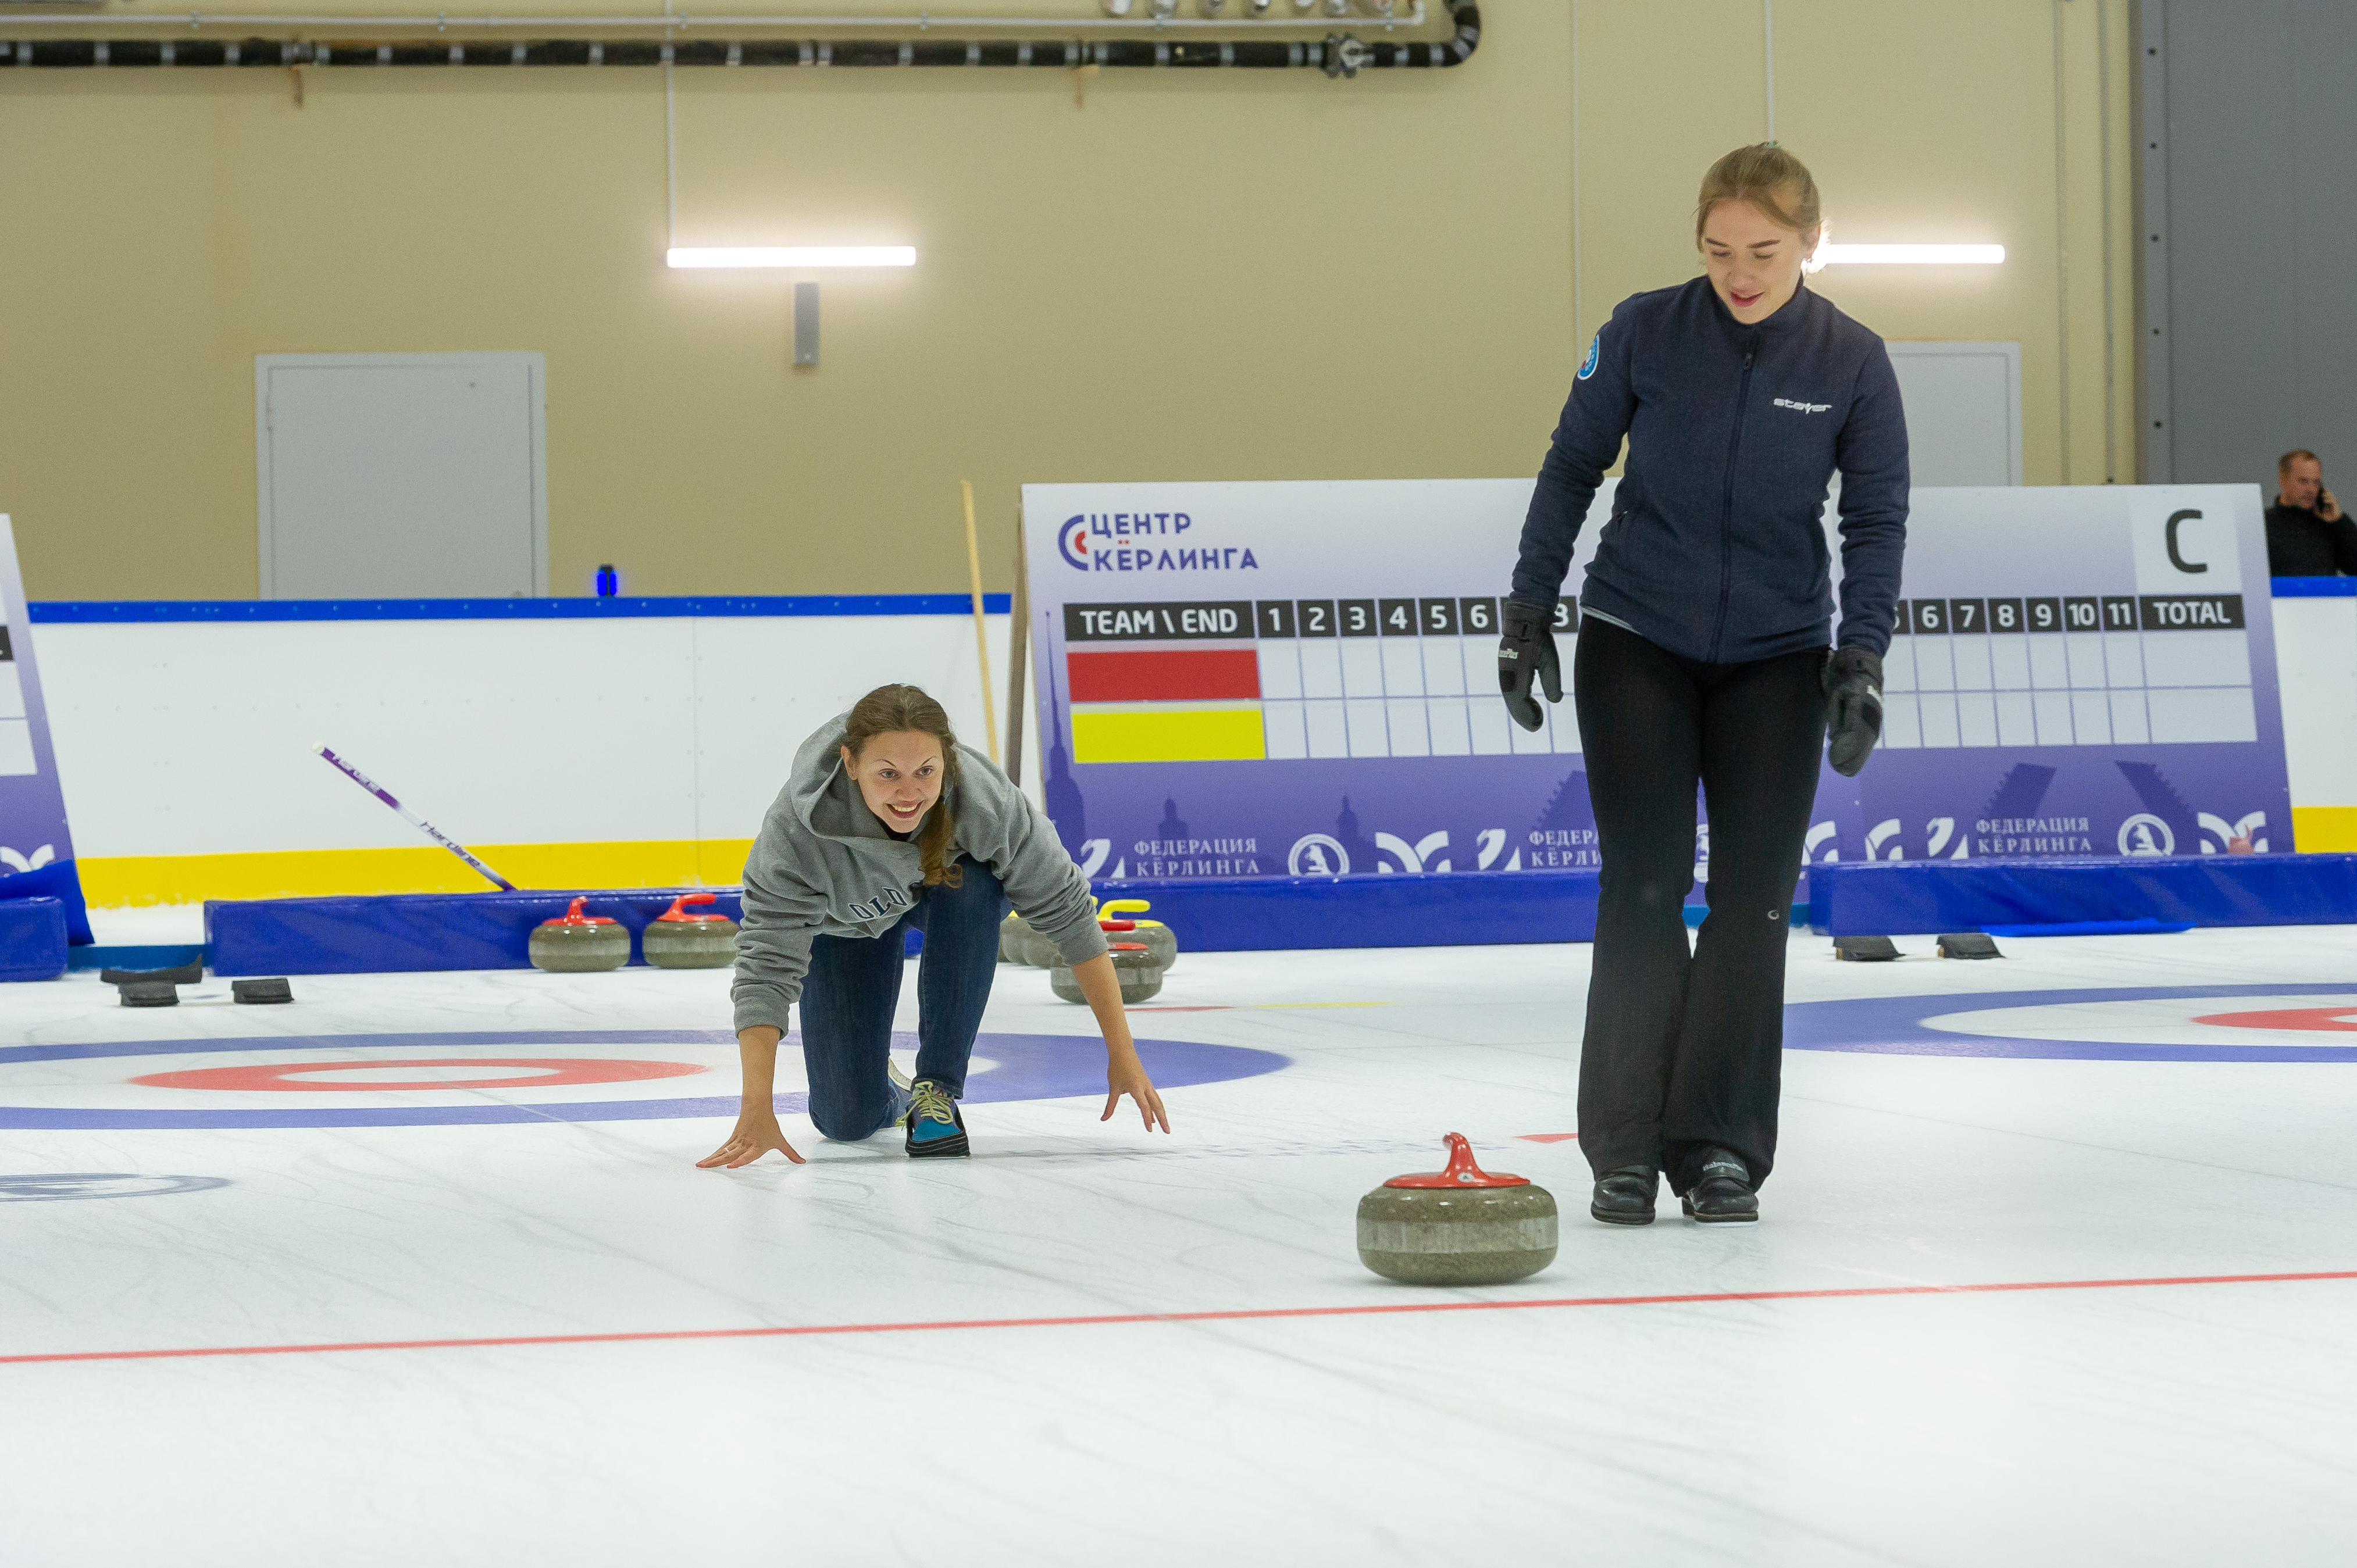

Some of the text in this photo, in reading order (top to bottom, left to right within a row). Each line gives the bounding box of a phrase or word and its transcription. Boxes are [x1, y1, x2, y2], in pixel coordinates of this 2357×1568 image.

[1090, 513, 1192, 538] ЦЕНТР
[1093, 539, 1258, 571] КЁРЛИНГА
[1079, 609, 1156, 635] TEAM
[1181, 609, 1239, 634] END
[1268, 608, 1281, 632] 1
[1308, 606, 1327, 632] 2
[1348, 606, 1367, 631] 3
[1389, 605, 1408, 630] 4
[1430, 605, 1449, 630] 5
[1470, 604, 1489, 629] 6
[1921, 605, 1940, 628] 6
[1960, 605, 1976, 627] 7
[1997, 603, 2015, 628] 8
[2035, 603, 2053, 627] 9
[2067, 603, 2095, 626] 10
[2108, 602, 2131, 625] 11
[2153, 601, 2233, 624] TOTAL
[1976, 817, 2089, 834] ФЕДЕРАЦИЯ
[1133, 837, 1257, 857] ФЕДЕРАЦИЯ
[1978, 835, 2092, 853] КЁРЛИНГА
[1137, 856, 1260, 877] КЁРЛИНГА
[848, 886, 908, 919] OLD
